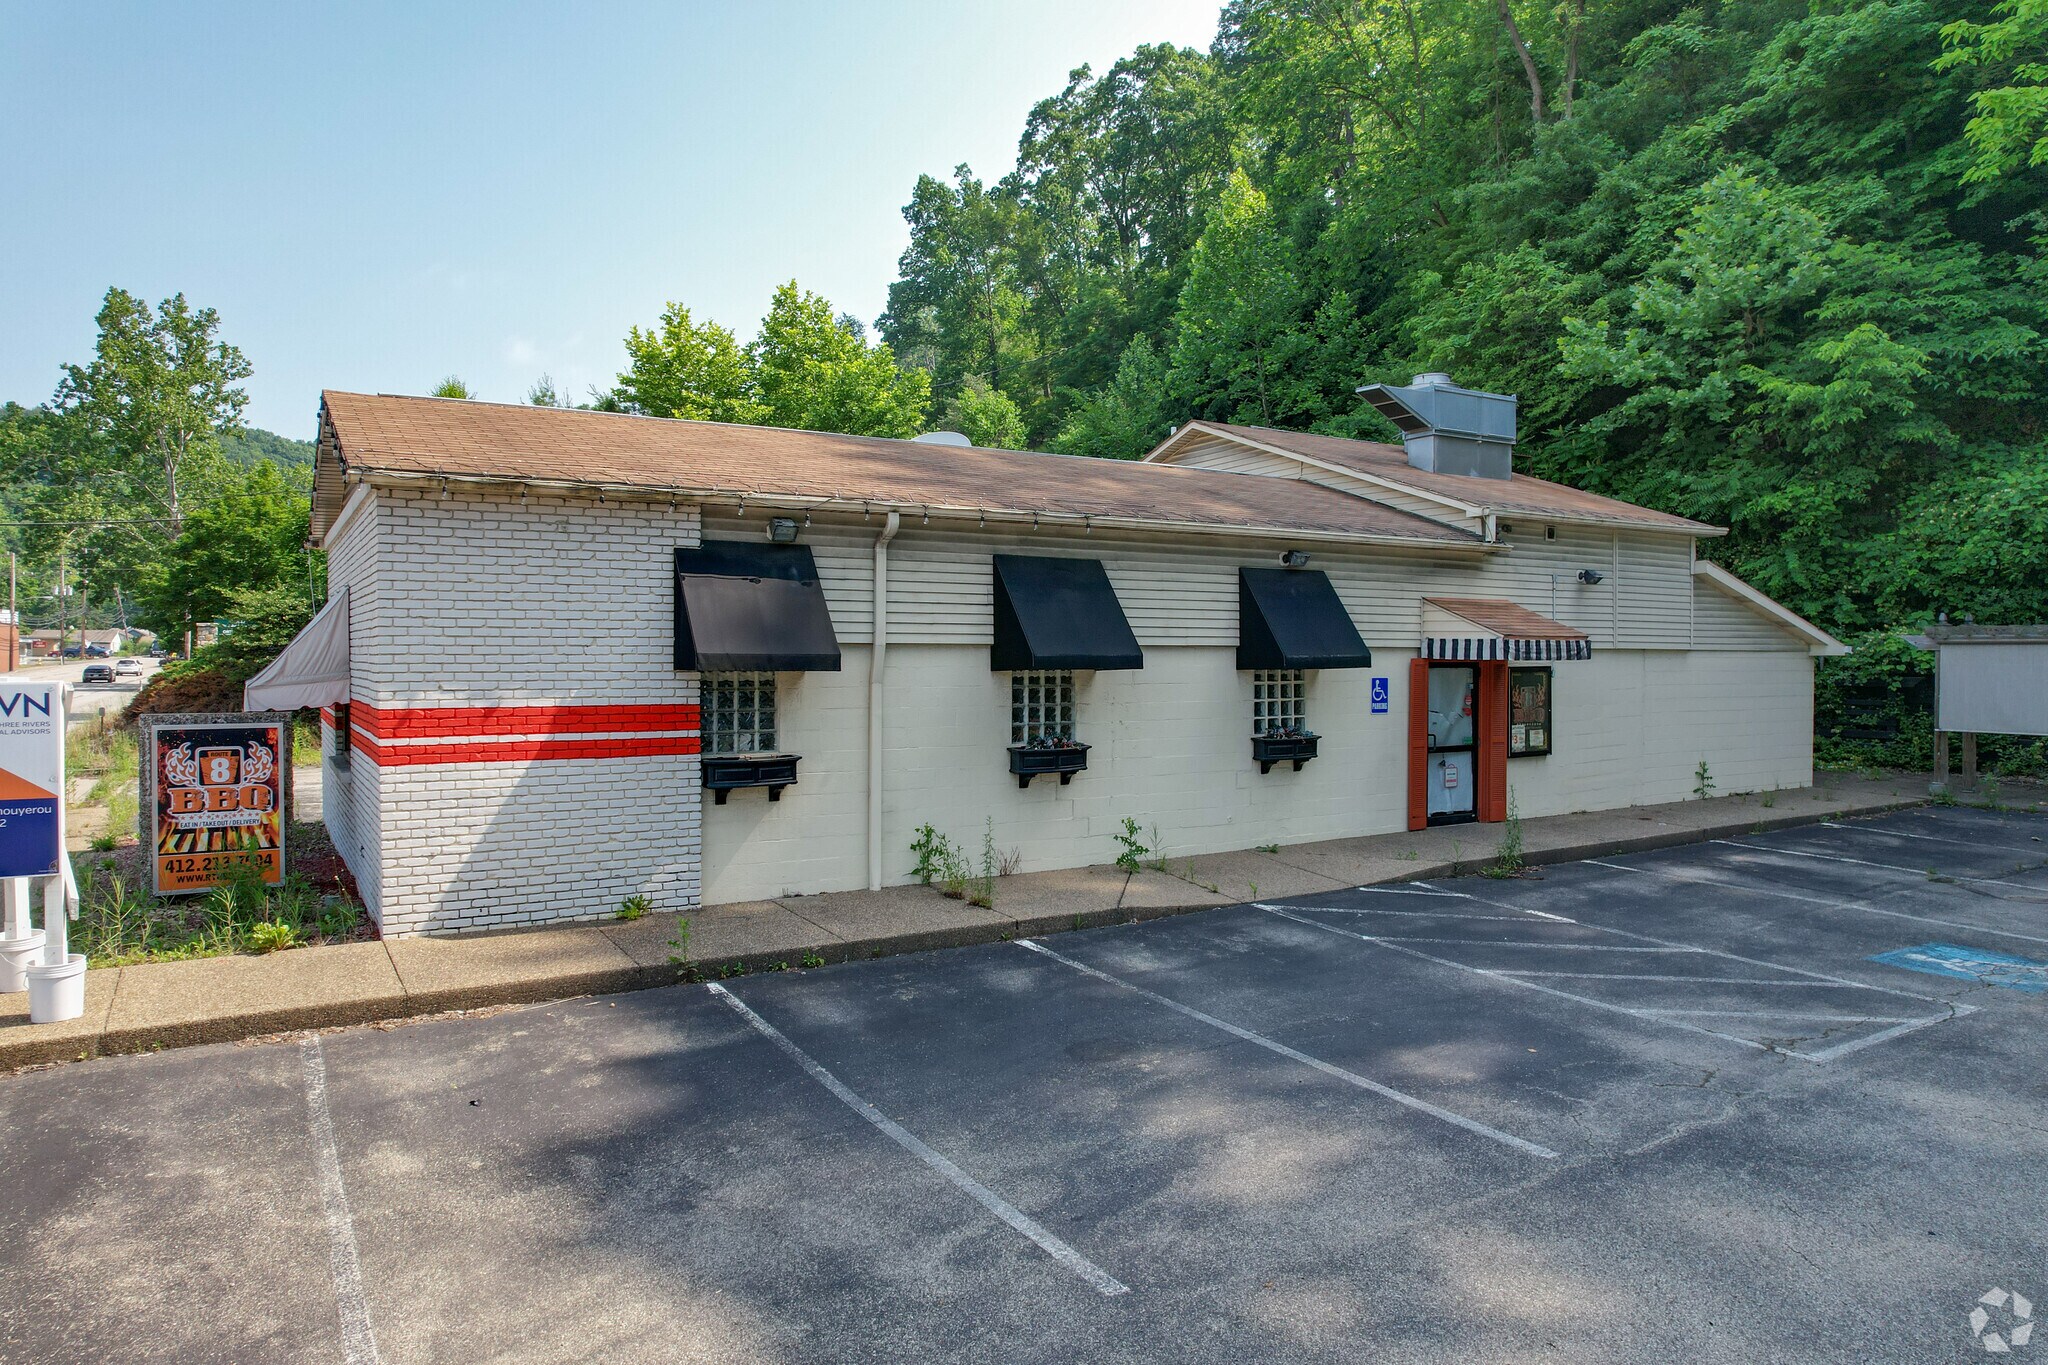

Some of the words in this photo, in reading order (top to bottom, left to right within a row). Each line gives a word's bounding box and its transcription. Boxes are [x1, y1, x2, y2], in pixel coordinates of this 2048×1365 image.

[22, 720, 51, 728] RIVERS
[210, 757, 230, 783] 8
[169, 785, 272, 814] BBQ
[233, 818, 260, 826] DELIVERY
